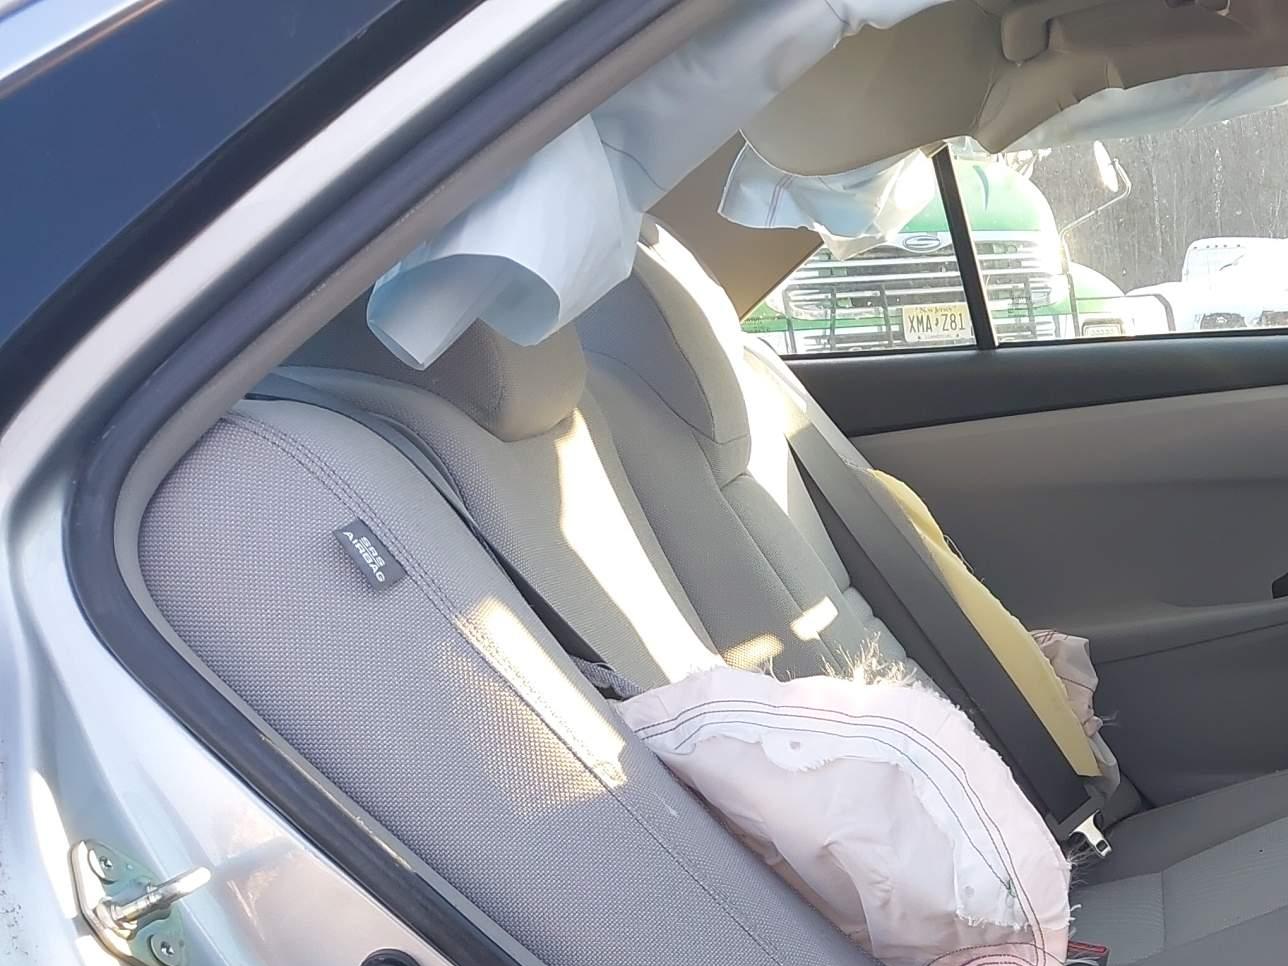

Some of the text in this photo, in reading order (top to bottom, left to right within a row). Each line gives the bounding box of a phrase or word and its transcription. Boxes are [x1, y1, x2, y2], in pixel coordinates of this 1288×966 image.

[908, 313, 966, 333] XMA Z81
[343, 531, 386, 582] AIRBAG
[360, 536, 386, 567] SRS
